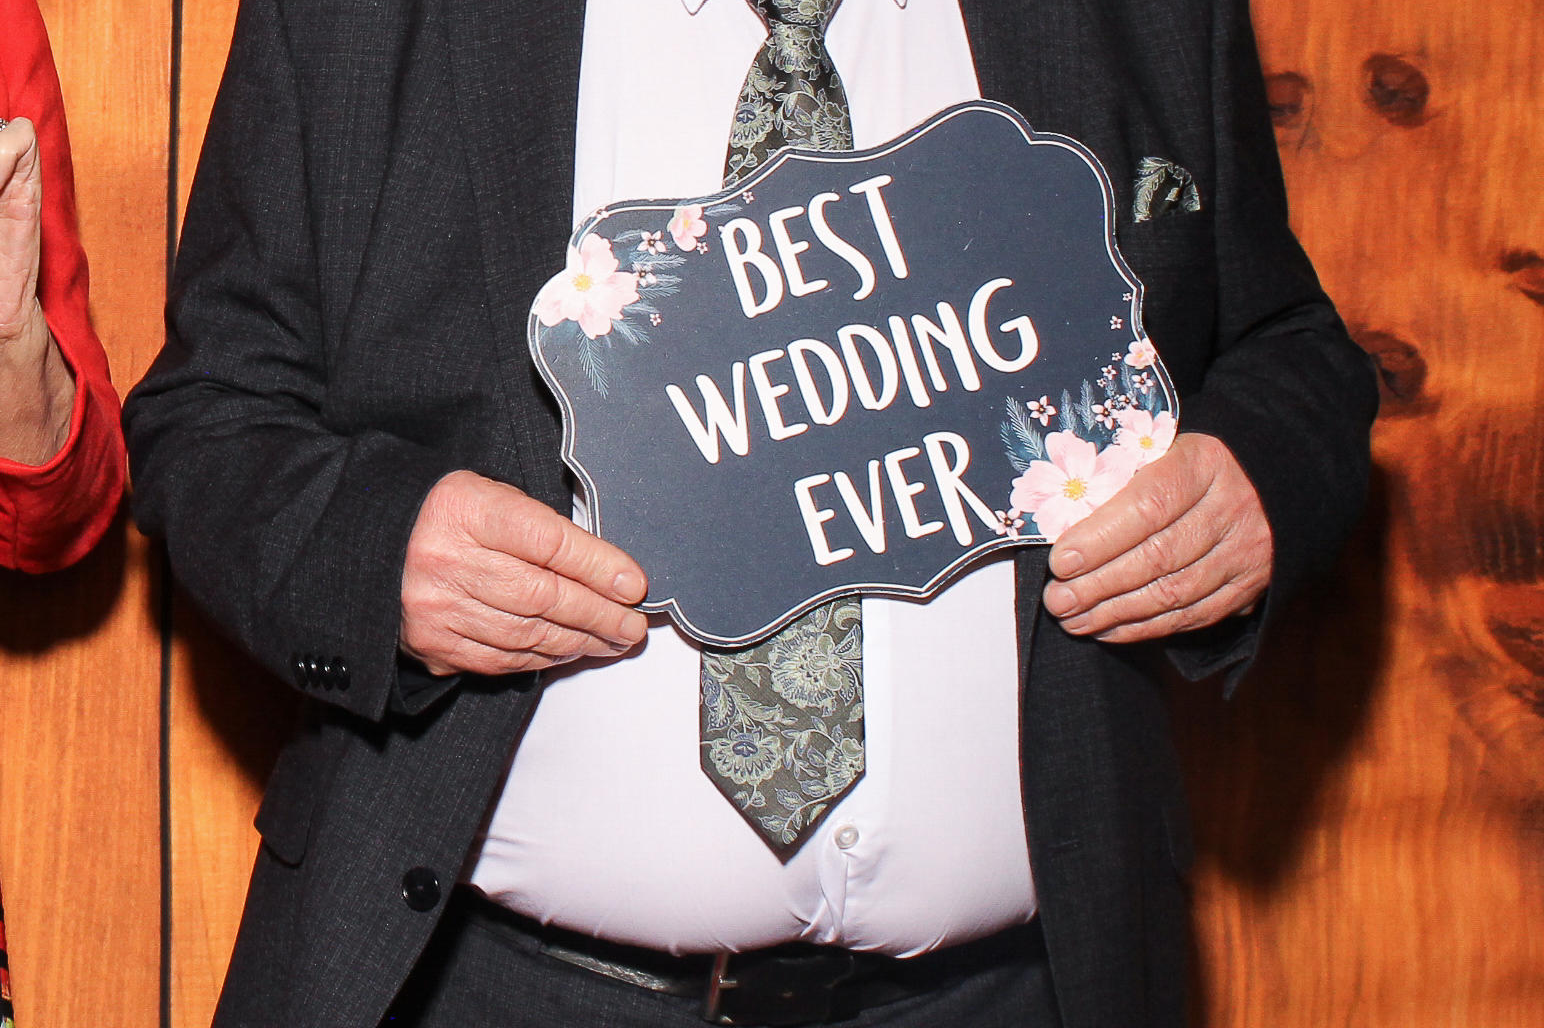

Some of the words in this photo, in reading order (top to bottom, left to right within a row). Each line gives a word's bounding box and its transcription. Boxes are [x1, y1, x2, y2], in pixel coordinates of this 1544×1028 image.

[720, 174, 908, 319] BEST
[665, 278, 1039, 464] WEDDING
[794, 431, 1002, 567] EVER
